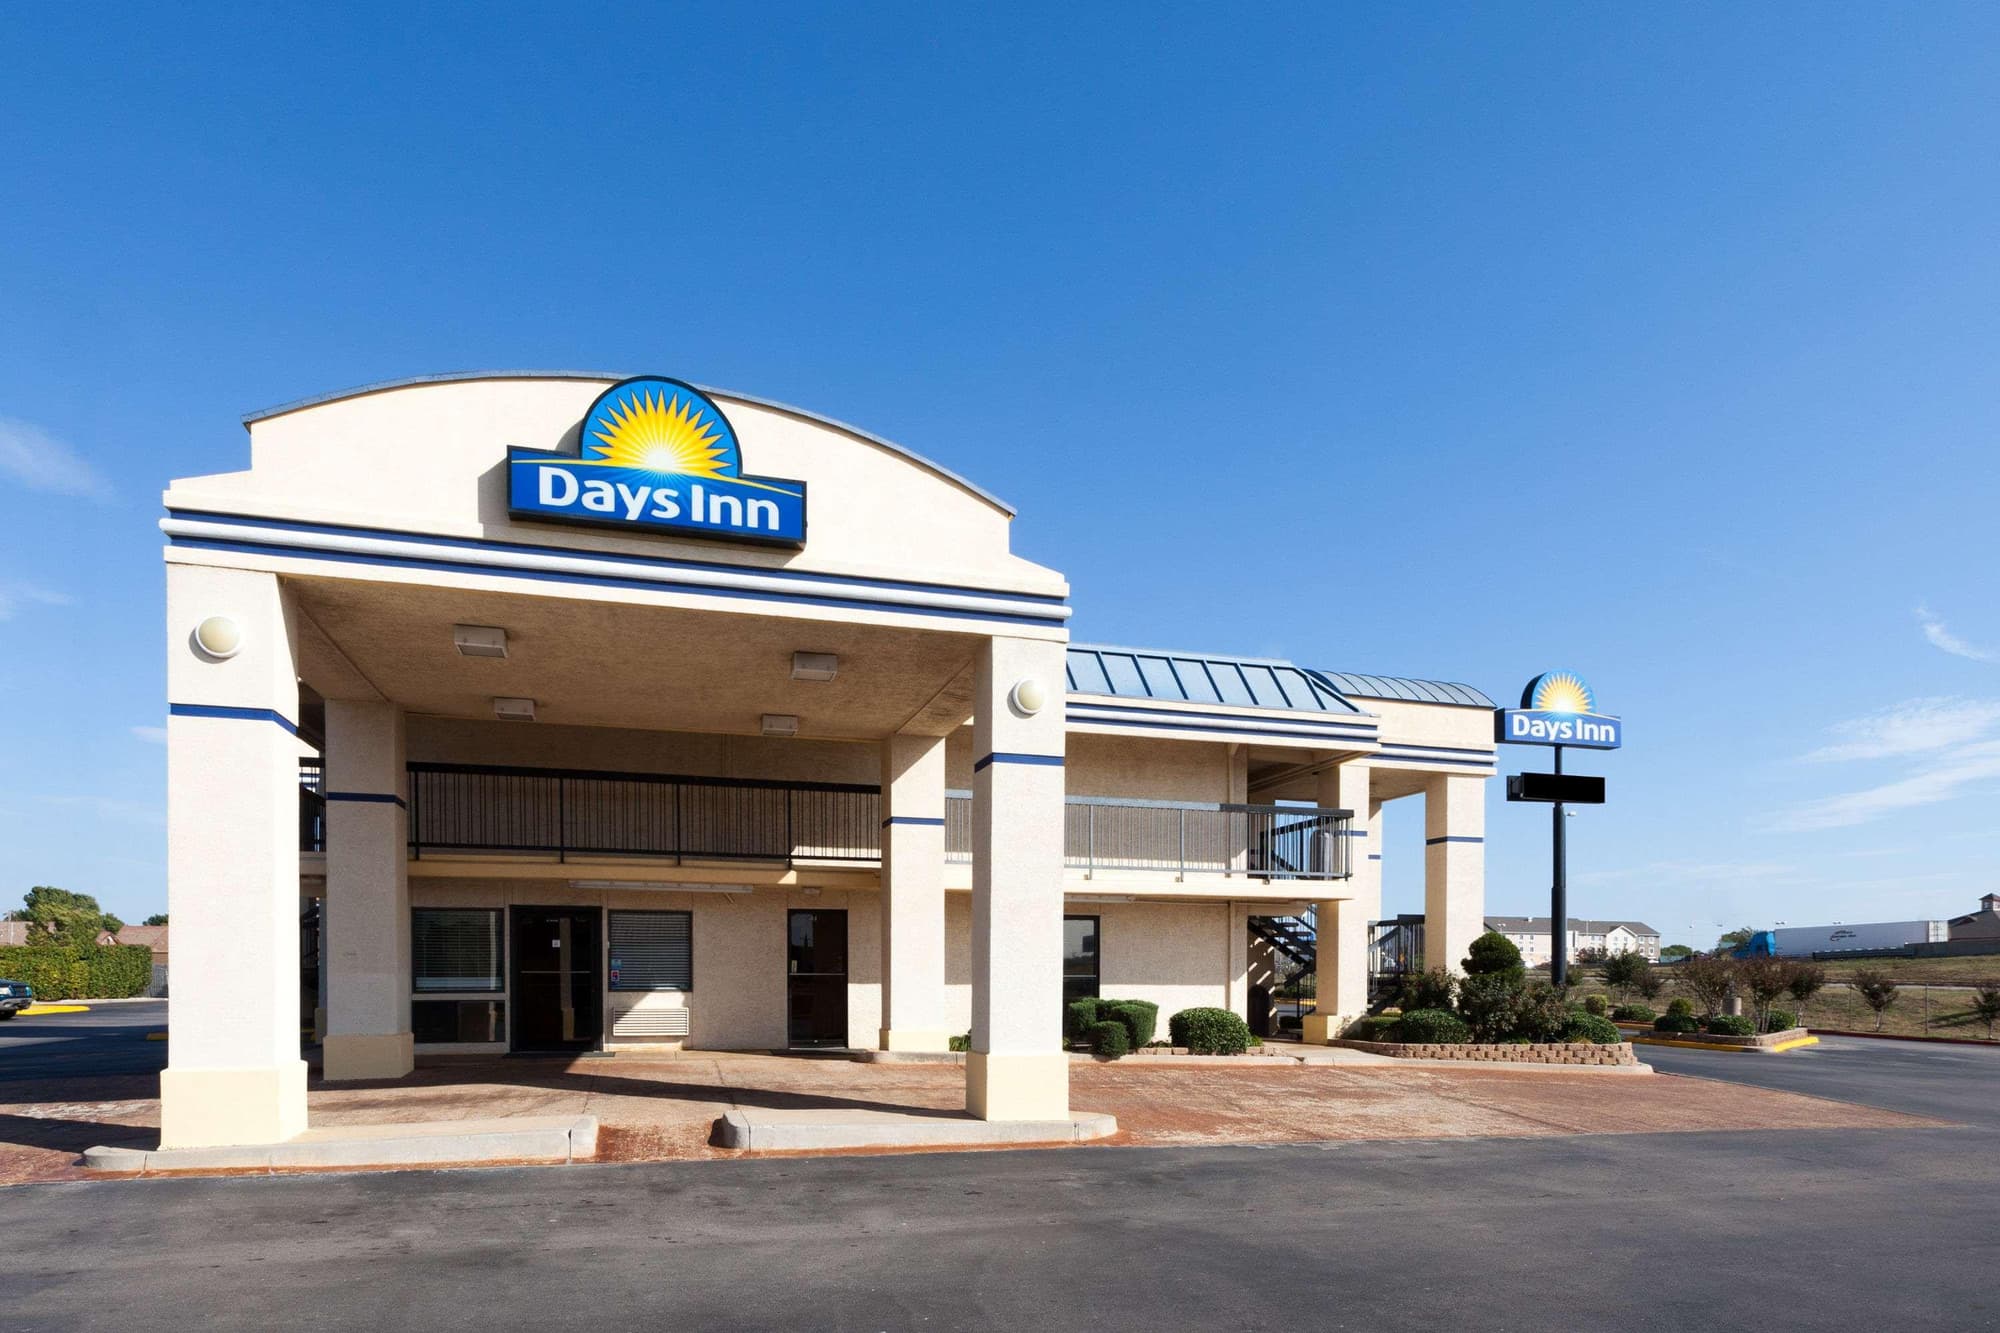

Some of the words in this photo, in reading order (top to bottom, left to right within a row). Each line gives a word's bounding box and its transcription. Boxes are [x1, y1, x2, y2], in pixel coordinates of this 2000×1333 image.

[538, 465, 681, 521] Days
[691, 484, 780, 531] Inn
[1512, 714, 1573, 741] Days
[1575, 718, 1615, 742] Inn
